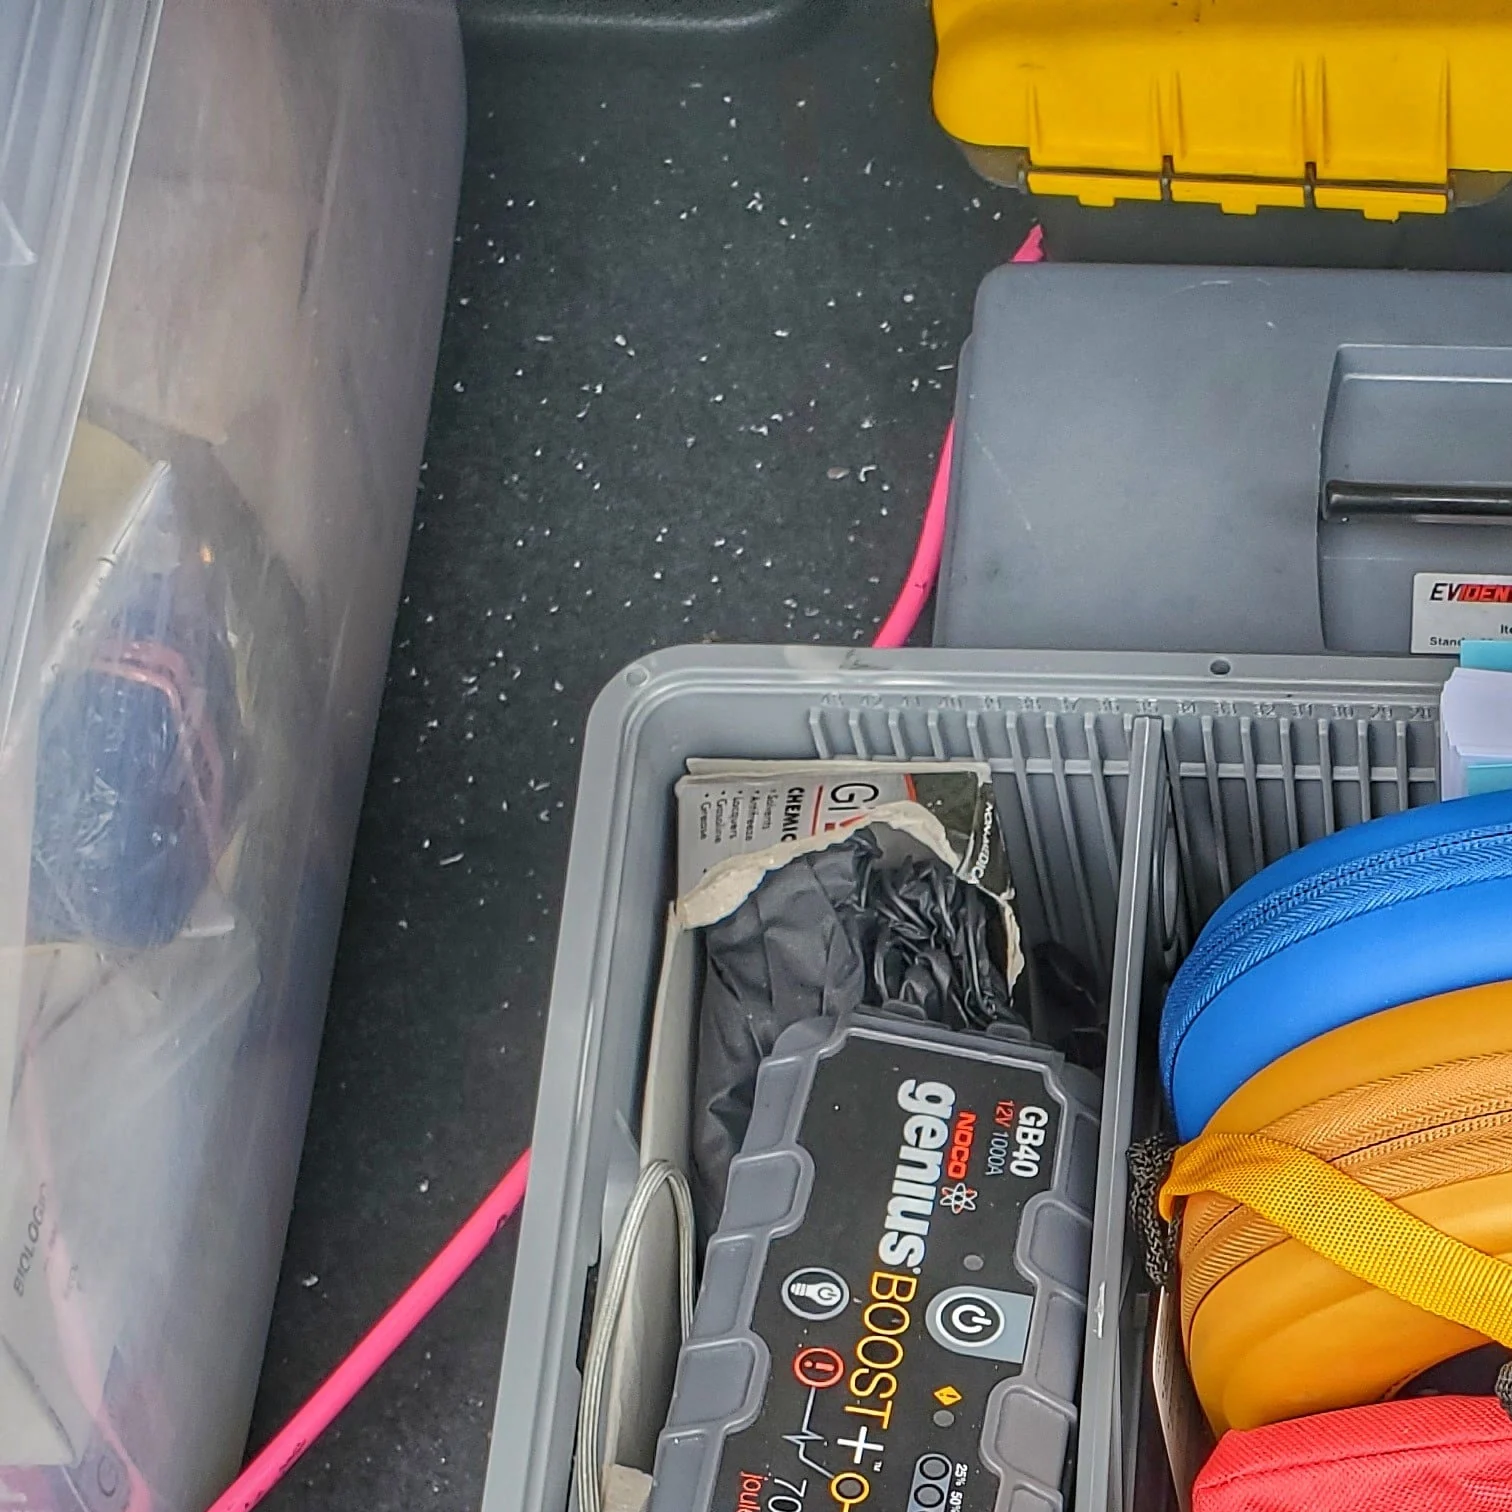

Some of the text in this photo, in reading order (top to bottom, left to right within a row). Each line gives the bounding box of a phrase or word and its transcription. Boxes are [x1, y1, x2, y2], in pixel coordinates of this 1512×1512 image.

[781, 787, 805, 842] CHEMIC
[947, 1111, 978, 1180] NOCO
[984, 1100, 1015, 1177] 12V 1000A
[1009, 1105, 1049, 1179] GB40
[954, 1462, 969, 1487] 25%
